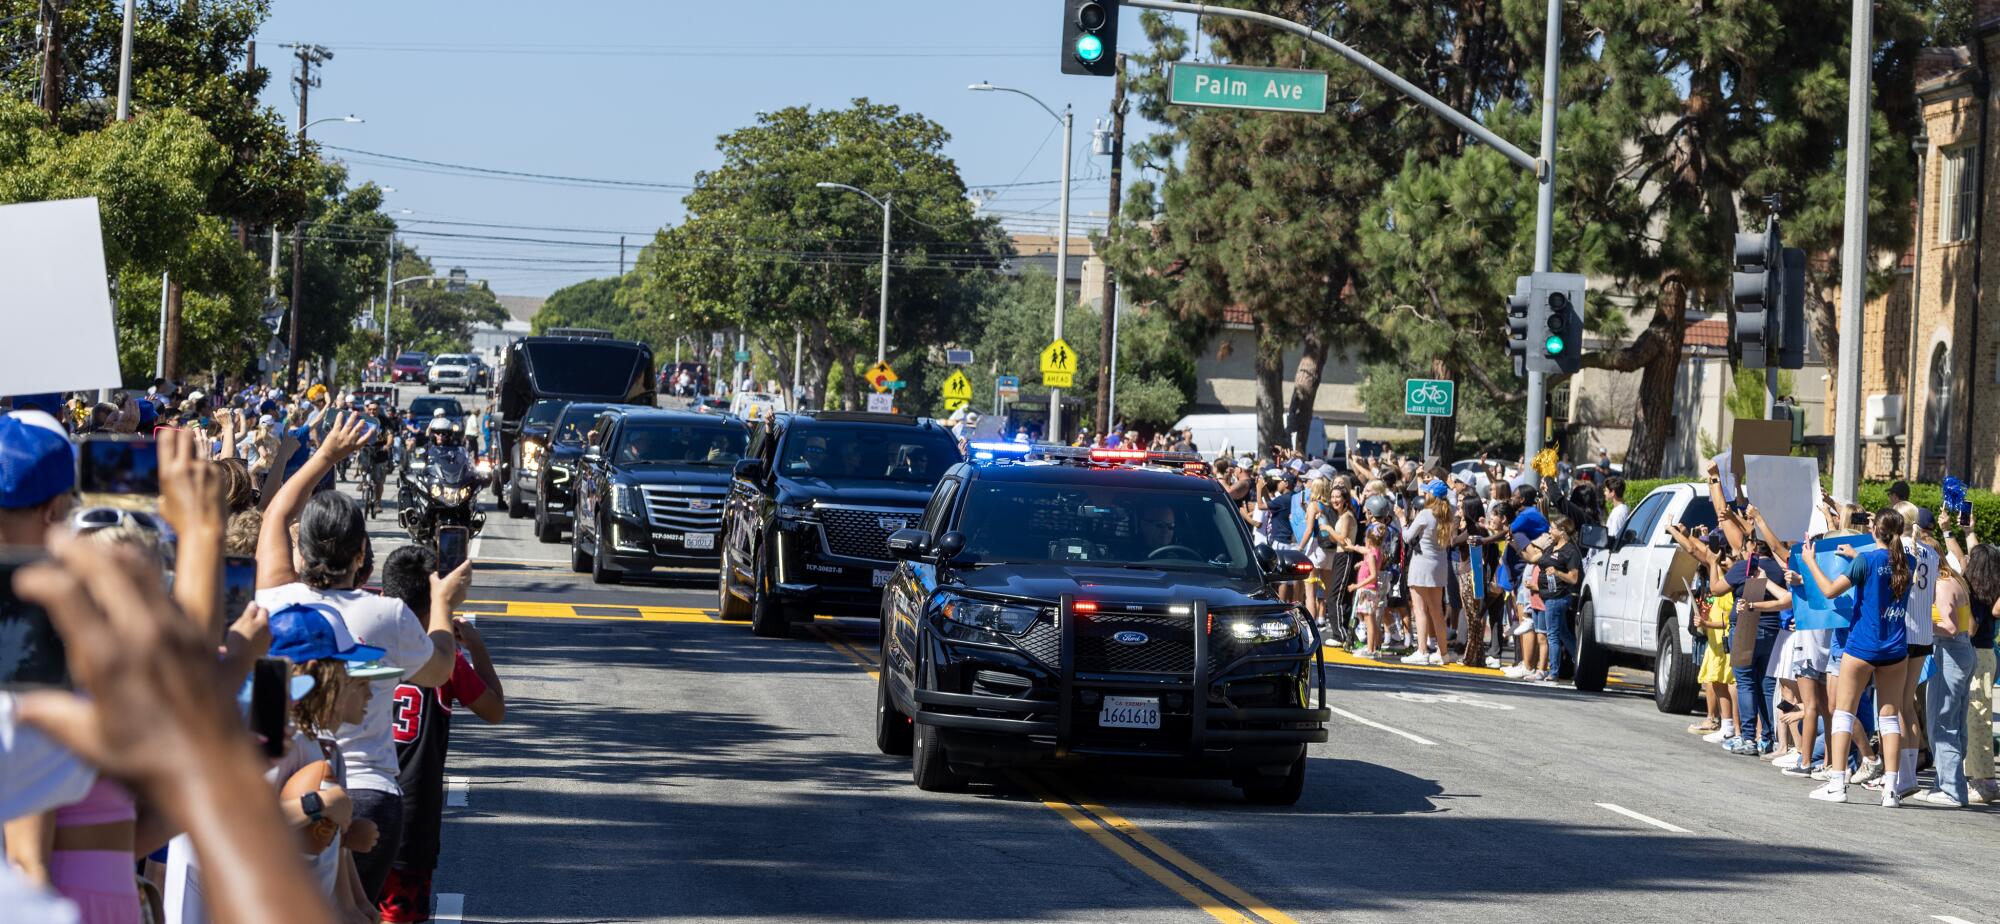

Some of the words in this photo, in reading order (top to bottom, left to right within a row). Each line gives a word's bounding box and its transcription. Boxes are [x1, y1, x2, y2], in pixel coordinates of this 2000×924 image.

[1195, 74, 1247, 97] Palm
[1264, 79, 1303, 100] Ave
[1046, 376, 1070, 384] AHEAD
[1412, 405, 1425, 413] BIKE
[1427, 406, 1446, 414] ROUTE
[1122, 634, 1141, 642] Ford
[1103, 707, 1157, 725] 1661618
